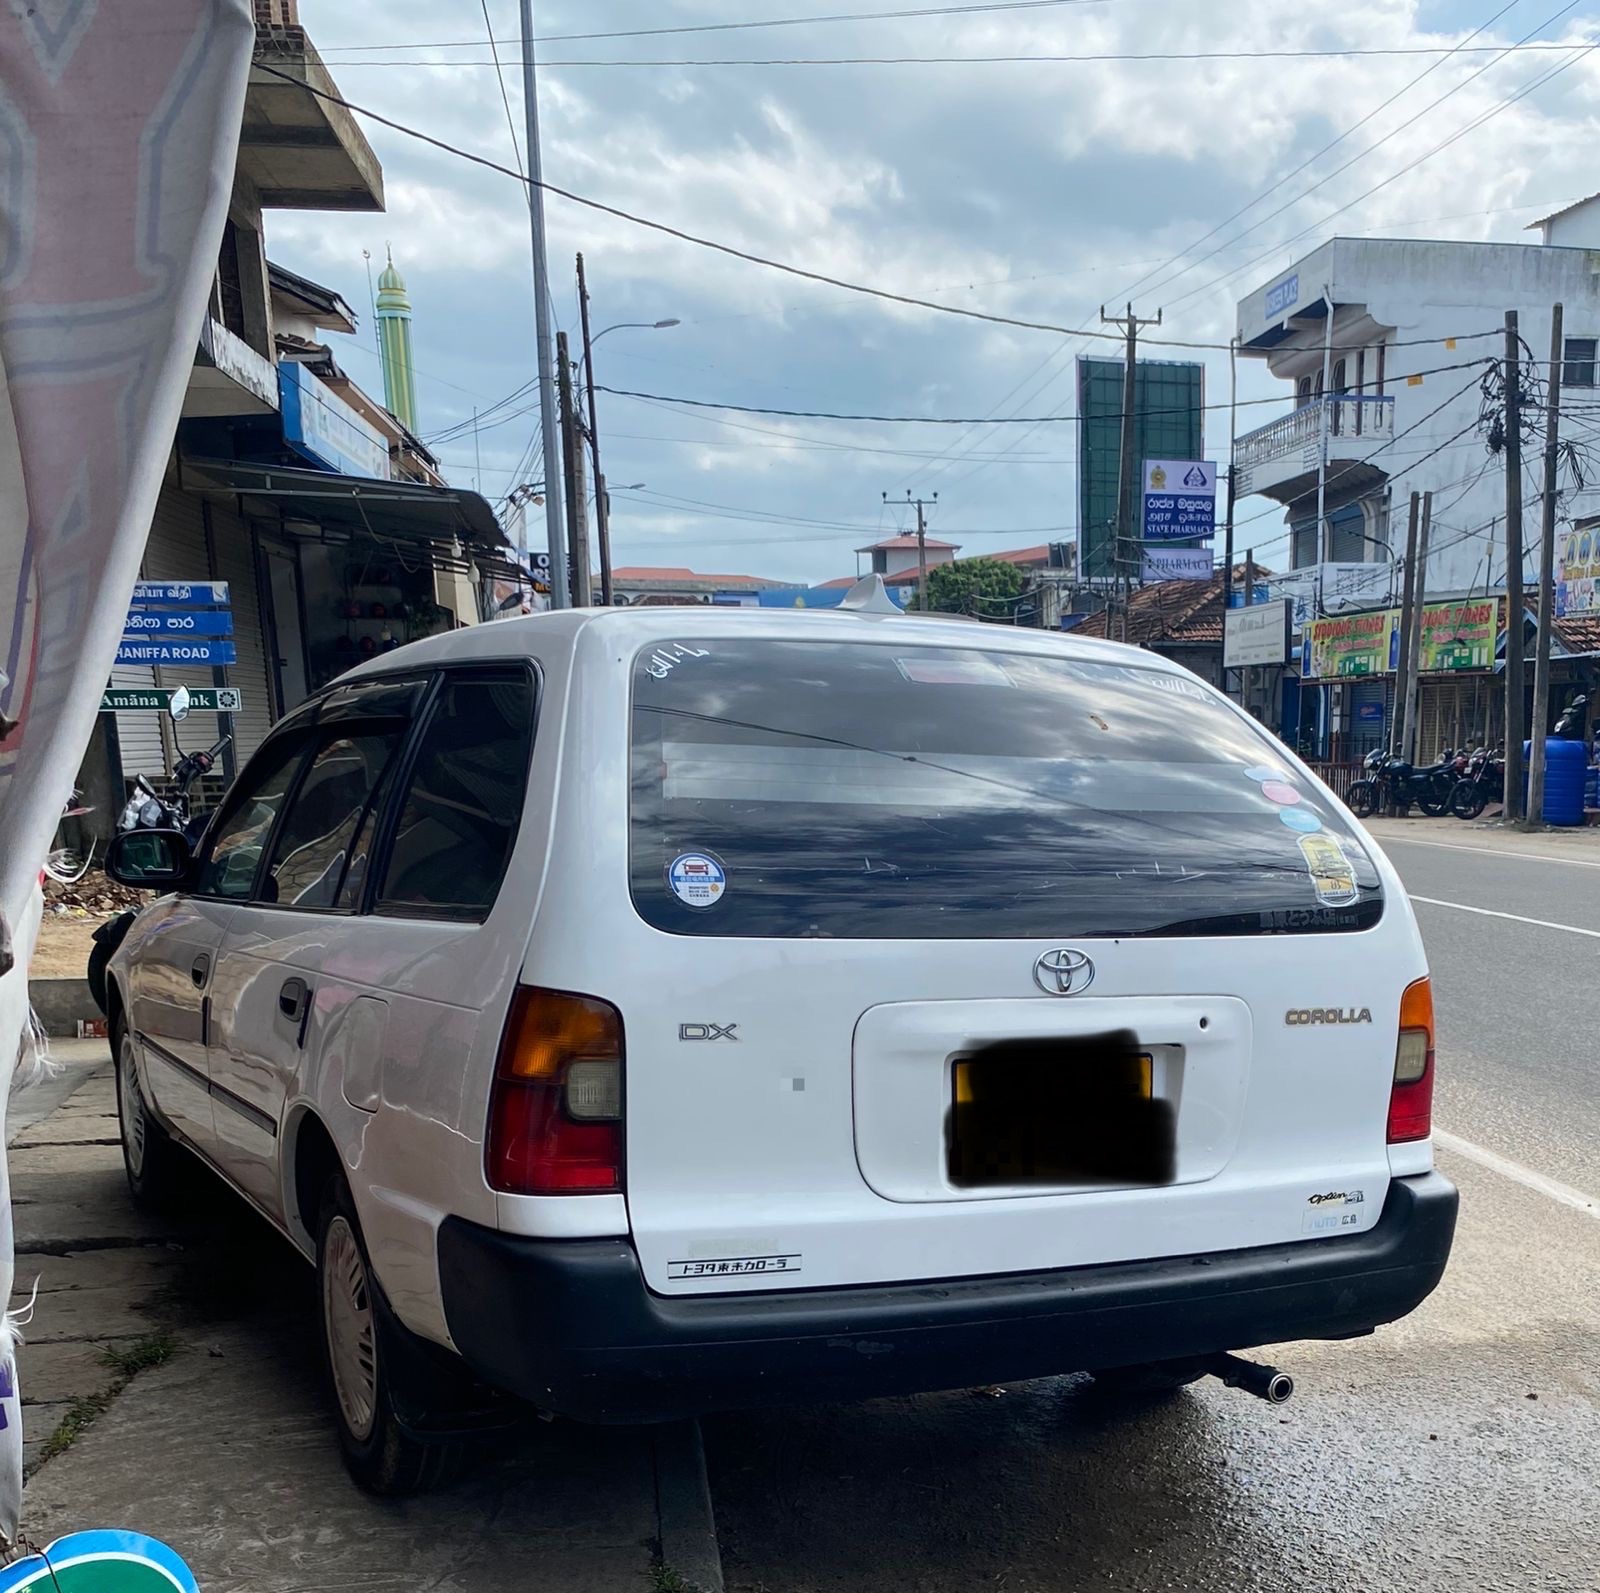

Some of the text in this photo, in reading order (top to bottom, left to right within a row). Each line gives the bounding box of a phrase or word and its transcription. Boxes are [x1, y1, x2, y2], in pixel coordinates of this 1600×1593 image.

[1147, 524, 1210, 534] STATE PHARMACY
[1156, 558, 1209, 570] PHARMACY
[167, 584, 192, 600] வீதி
[166, 616, 195, 629] පාර
[172, 647, 210, 659] ROAD
[1285, 1008, 1372, 1025] COROLLA
[679, 1023, 738, 1041] DX
[1308, 1192, 1346, 1204] Option
